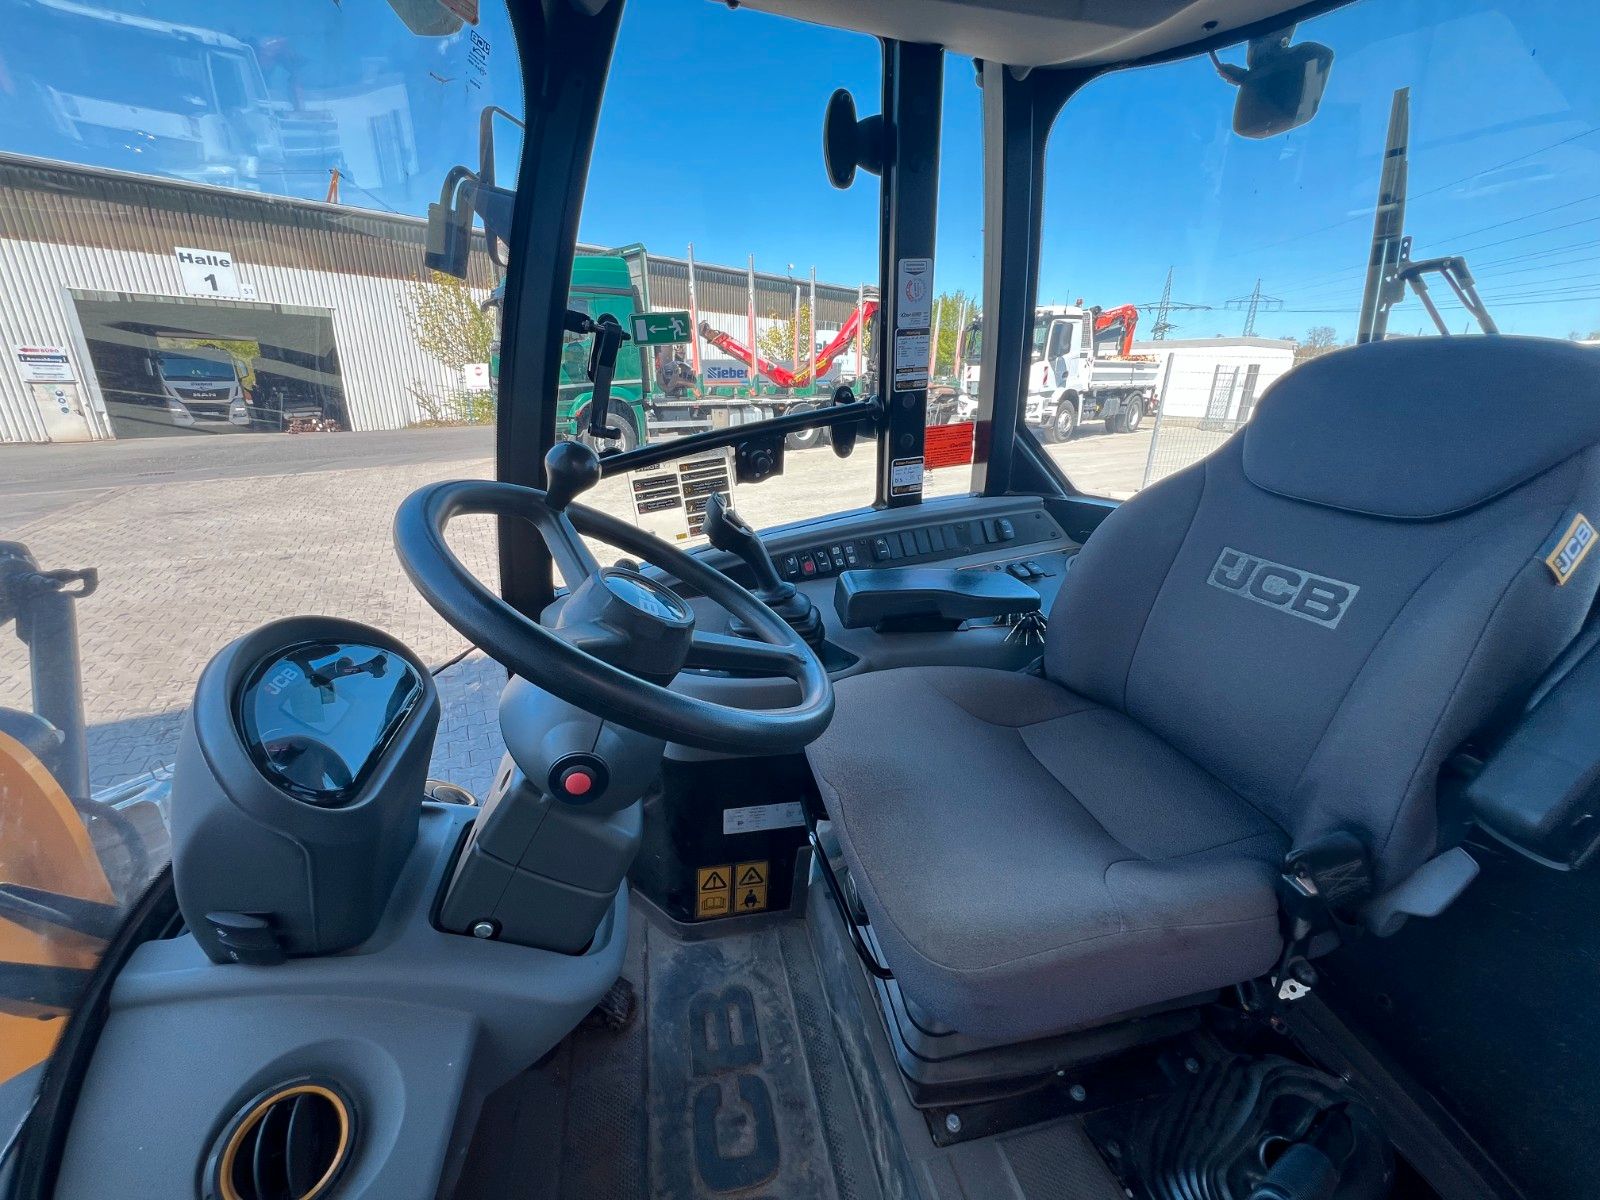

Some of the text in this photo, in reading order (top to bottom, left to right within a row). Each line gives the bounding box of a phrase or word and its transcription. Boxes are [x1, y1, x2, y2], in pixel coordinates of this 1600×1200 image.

[178, 252, 231, 268] Halle
[204, 273, 218, 291] 1
[1554, 522, 1593, 574] JCB
[1210, 550, 1355, 624] JCB
[267, 668, 298, 695] JCB
